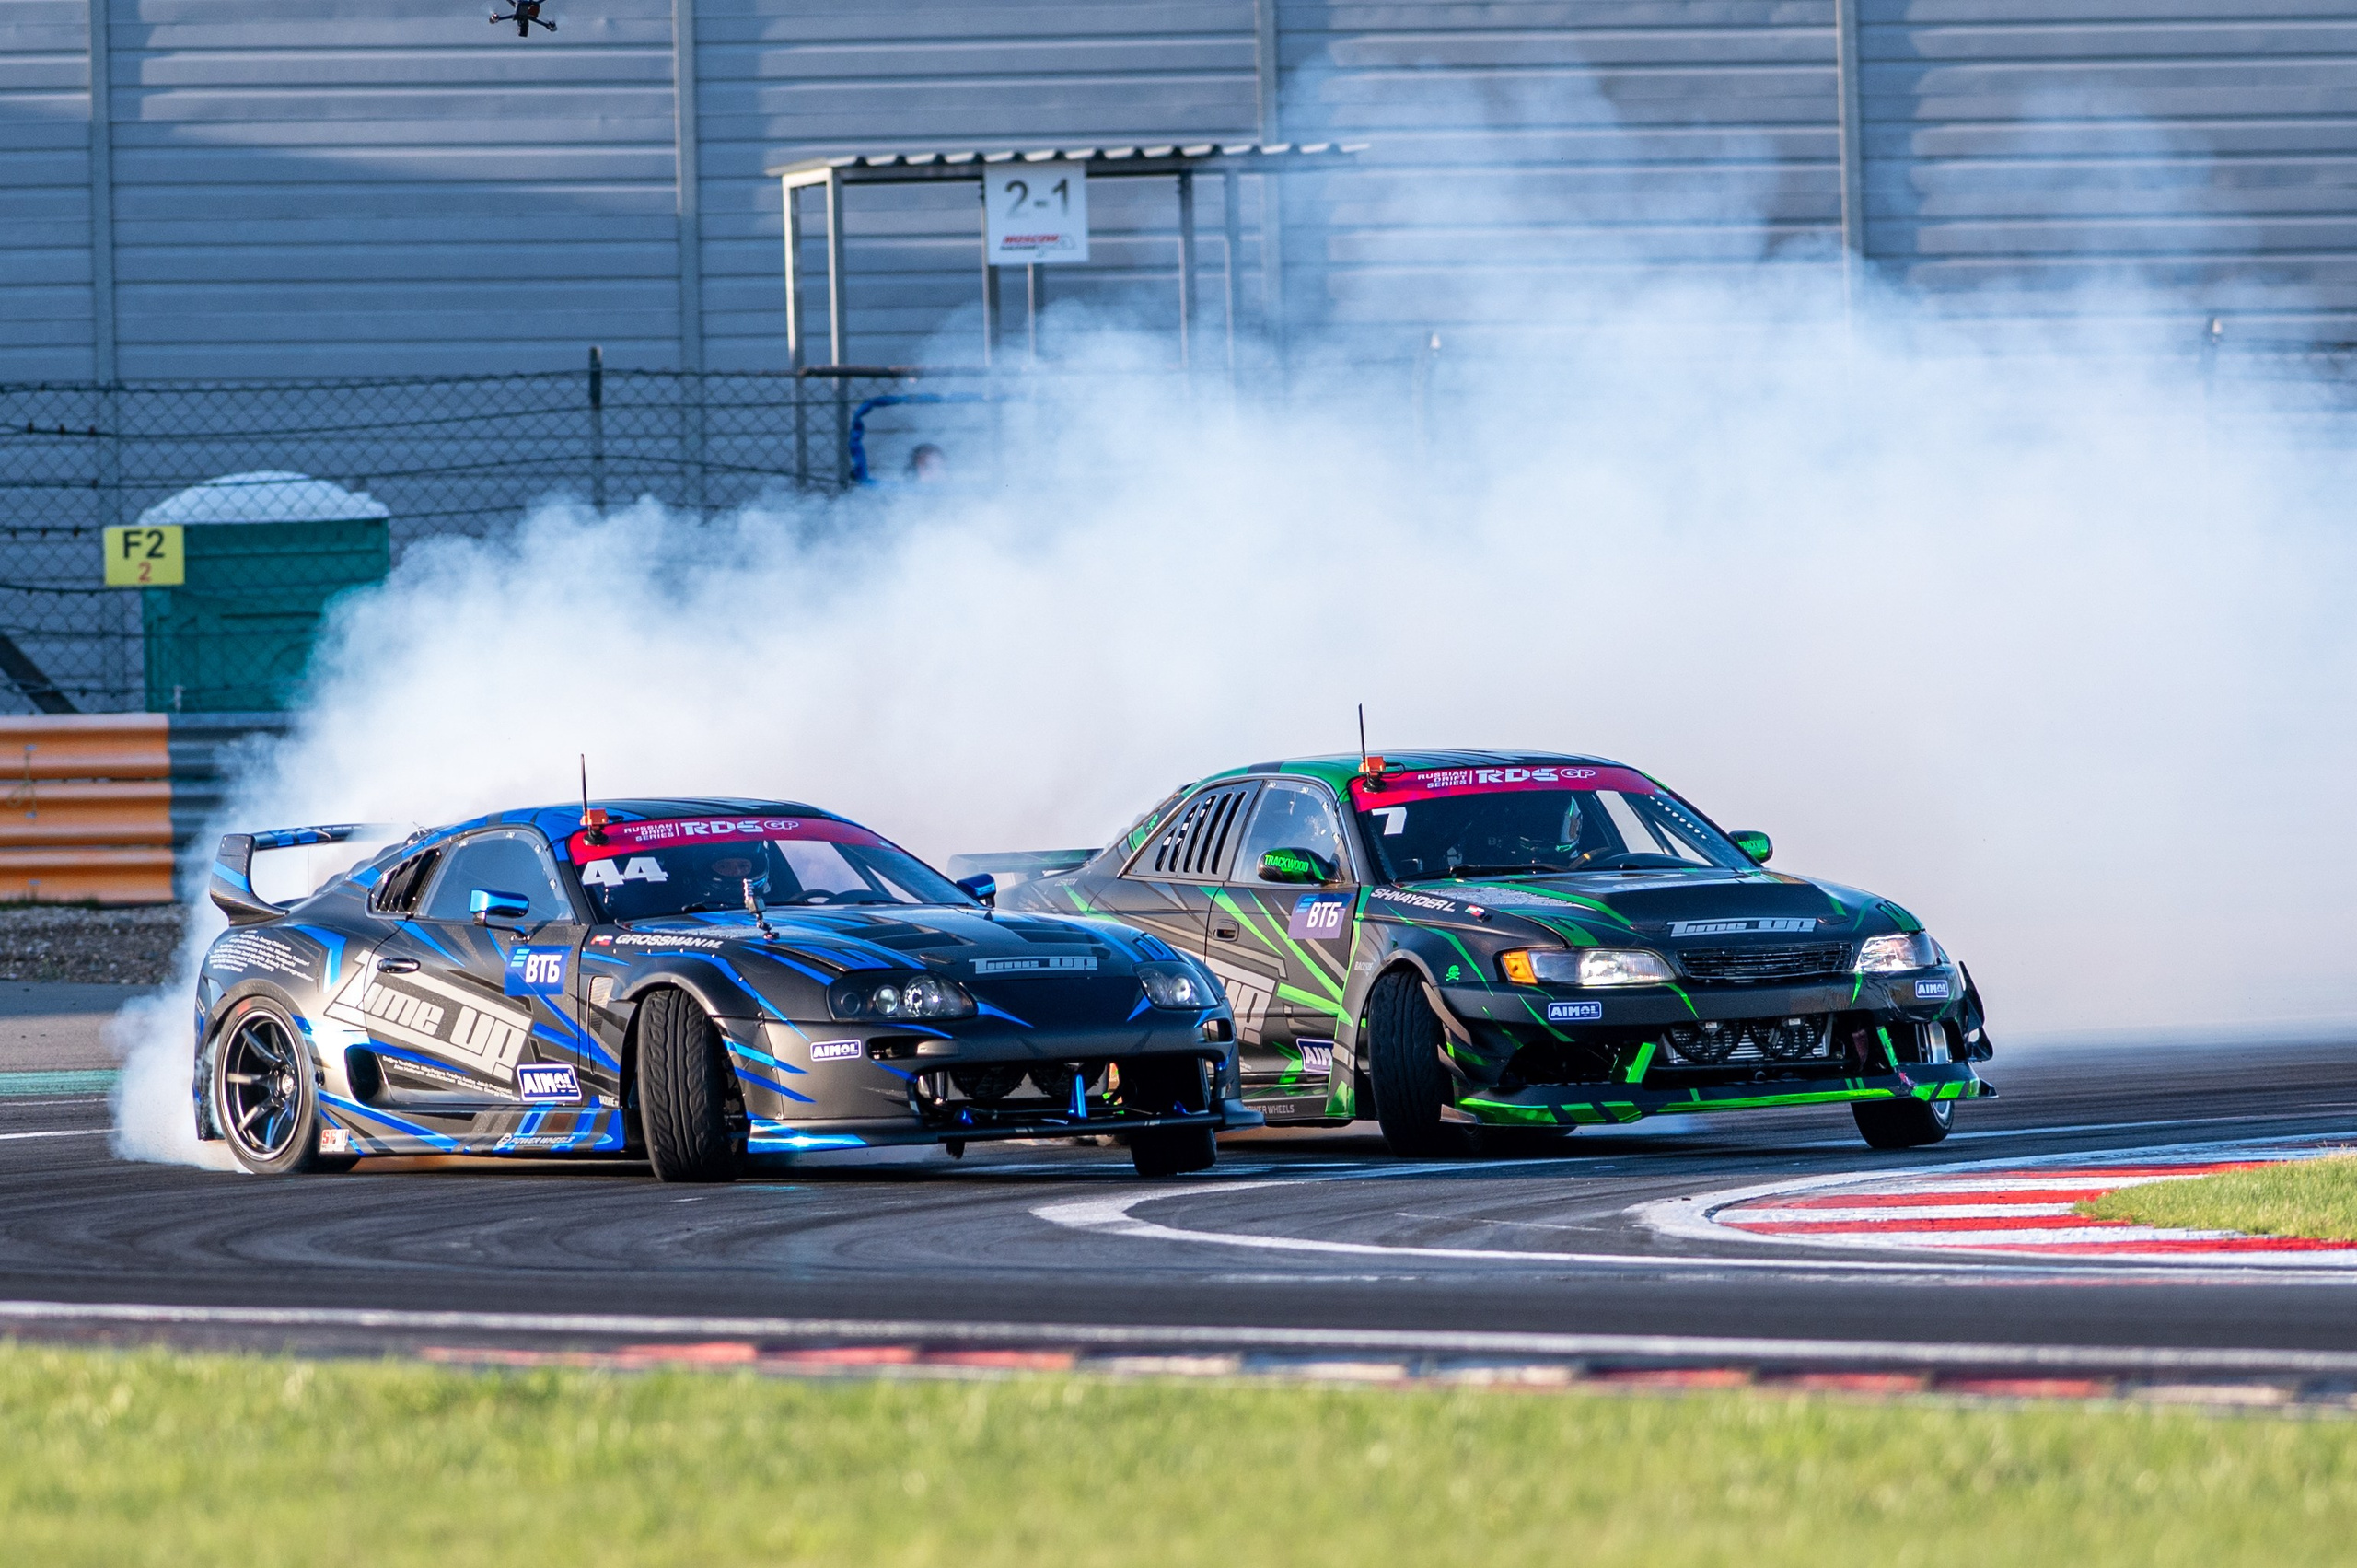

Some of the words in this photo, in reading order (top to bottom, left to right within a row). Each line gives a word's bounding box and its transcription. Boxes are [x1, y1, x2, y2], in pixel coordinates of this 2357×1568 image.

[1004, 179, 1069, 219] 2-1
[122, 528, 166, 559] F2
[138, 561, 152, 583] 2
[1418, 770, 1468, 781] RUSSIAN
[1434, 775, 1466, 784] DRIFT
[1476, 768, 1559, 784] RDS
[1561, 768, 1596, 779] GP
[1427, 779, 1467, 789] SERIES
[623, 822, 674, 834] RUSSIAN
[640, 827, 673, 837] DRIFT
[680, 820, 764, 836] RDS
[764, 819, 799, 830] GP
[635, 832, 675, 842] SERIES
[1264, 854, 1309, 873] TRACKWOOD
[582, 856, 669, 887] 44
[1371, 888, 1446, 911] SHNAYDER
[1306, 901, 1343, 928] ВТБ
[615, 934, 702, 947] GROSSMAN
[525, 954, 563, 983] ВТБ
[1918, 983, 1947, 994] AIMOL
[1550, 1005, 1599, 1017] AIMOL
[813, 1043, 858, 1058] AIMOL
[522, 1072, 578, 1094] AIMOL
[1268, 1104, 1295, 1114] WHEELS
